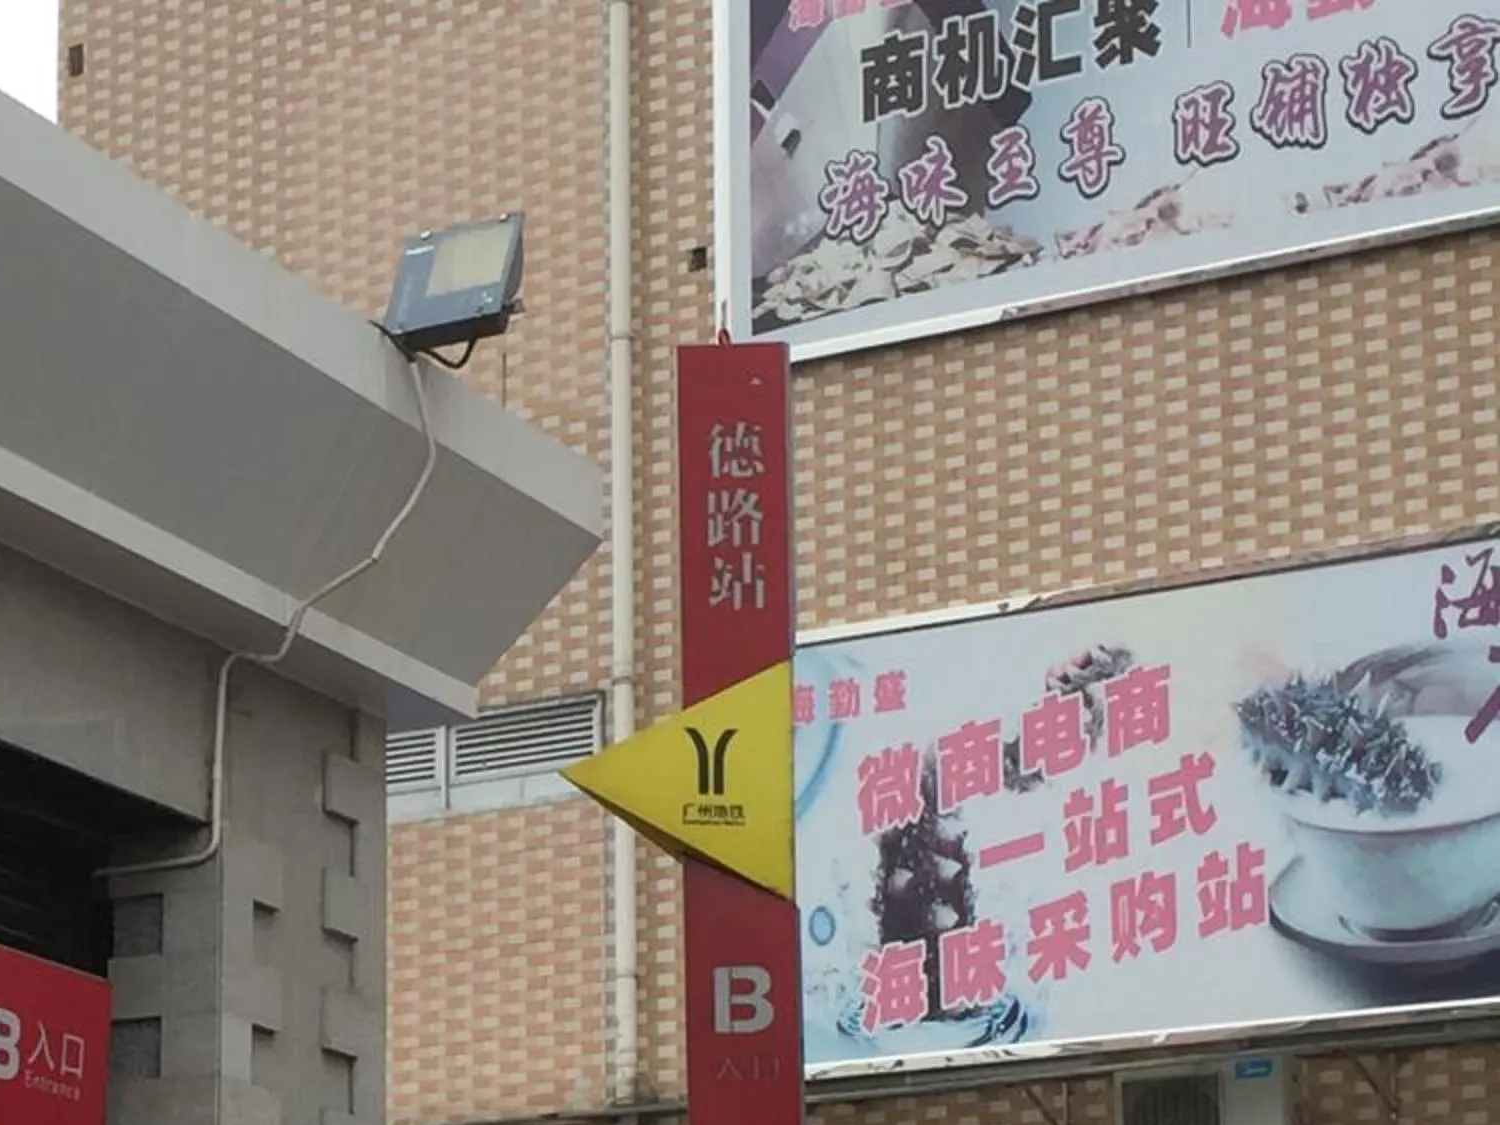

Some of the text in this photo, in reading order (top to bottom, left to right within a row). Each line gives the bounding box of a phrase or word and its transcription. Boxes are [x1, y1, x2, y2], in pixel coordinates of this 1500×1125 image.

[860, 0, 1164, 123] 商机汇聚
[819, 97, 1126, 240] 海味至尊
[855, 664, 1172, 836] 微商电商
[977, 753, 1220, 875] 一站式
[713, 965, 775, 1034] B
[859, 842, 1267, 1034] 海味采购站
[28, 1020, 85, 1080] 入口
